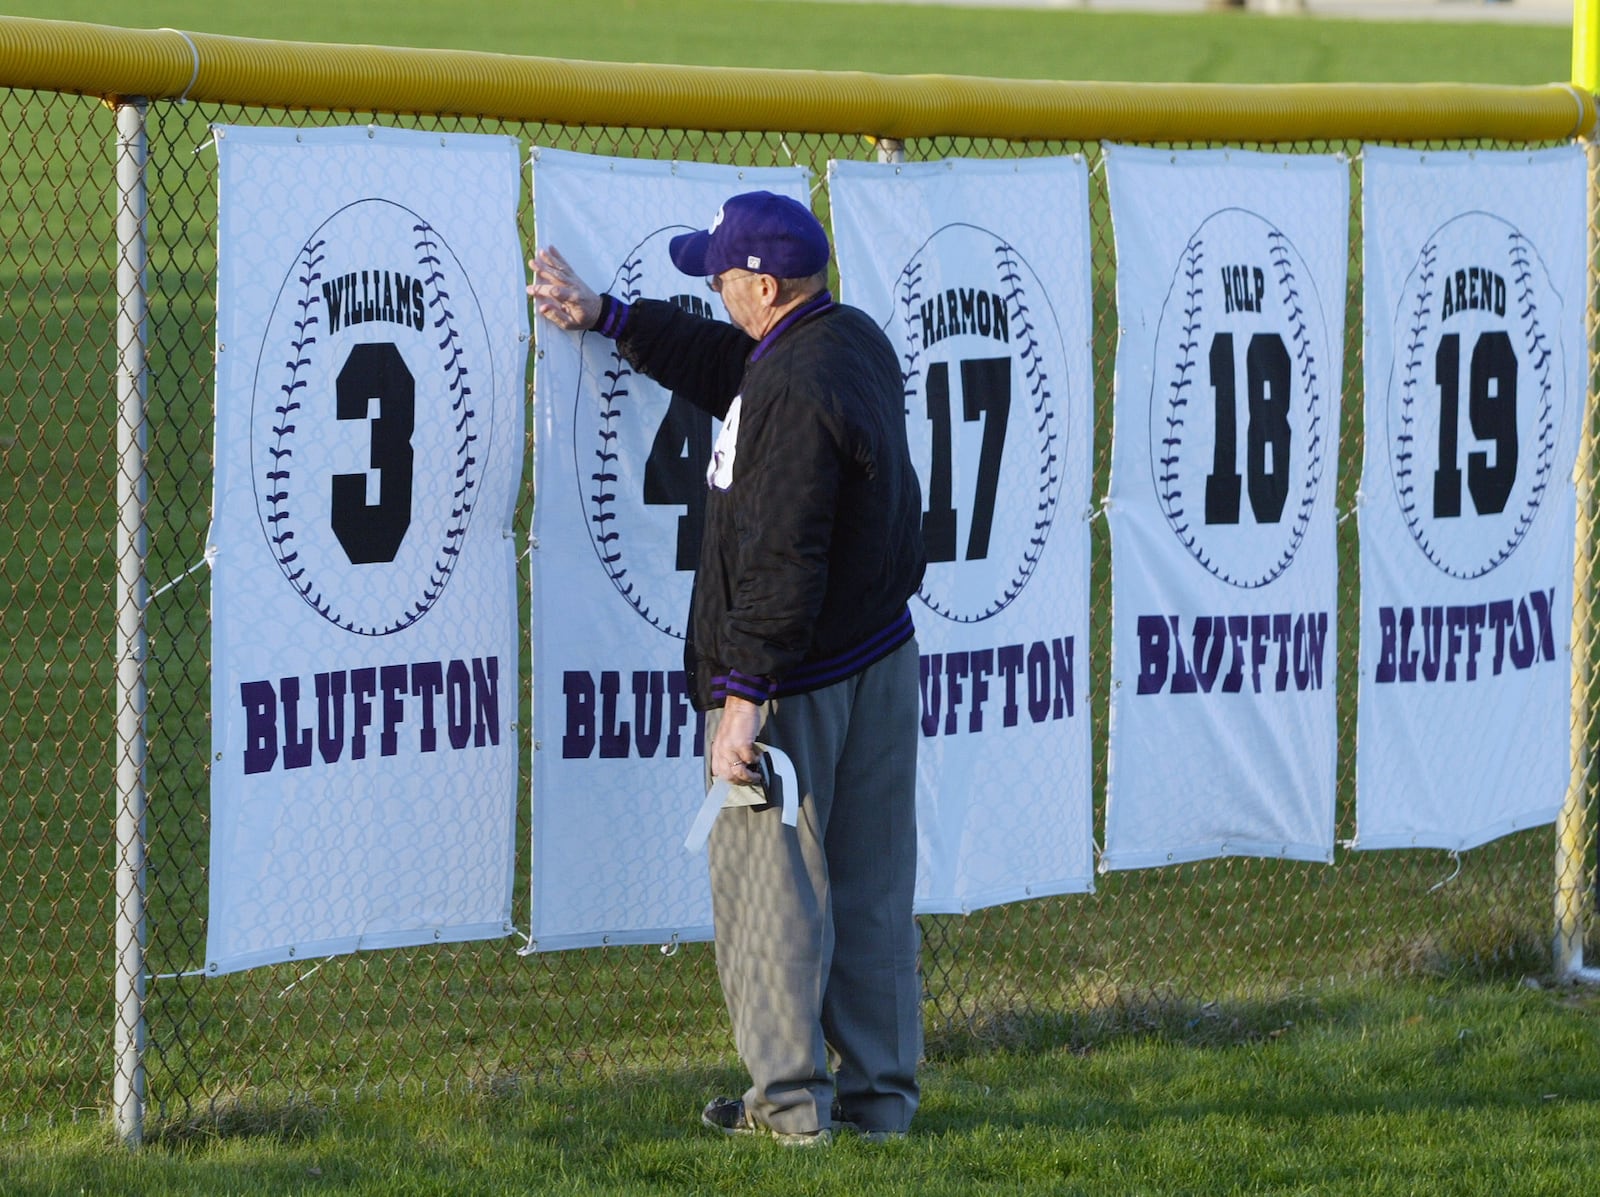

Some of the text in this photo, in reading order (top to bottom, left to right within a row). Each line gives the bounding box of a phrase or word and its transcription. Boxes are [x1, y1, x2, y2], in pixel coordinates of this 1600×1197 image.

[322, 270, 425, 334] WILLIAMS
[921, 287, 1010, 350] HARMON
[1222, 265, 1265, 313] HOLP
[1442, 267, 1506, 321] AREND
[331, 343, 415, 564] 3
[922, 356, 1012, 564] 17
[1205, 332, 1292, 525] 18
[1434, 331, 1519, 518] 19
[1137, 613, 1328, 696] BLUFFTON
[1376, 588, 1556, 684] BLUFFTON
[240, 656, 500, 775] BLUFFTON
